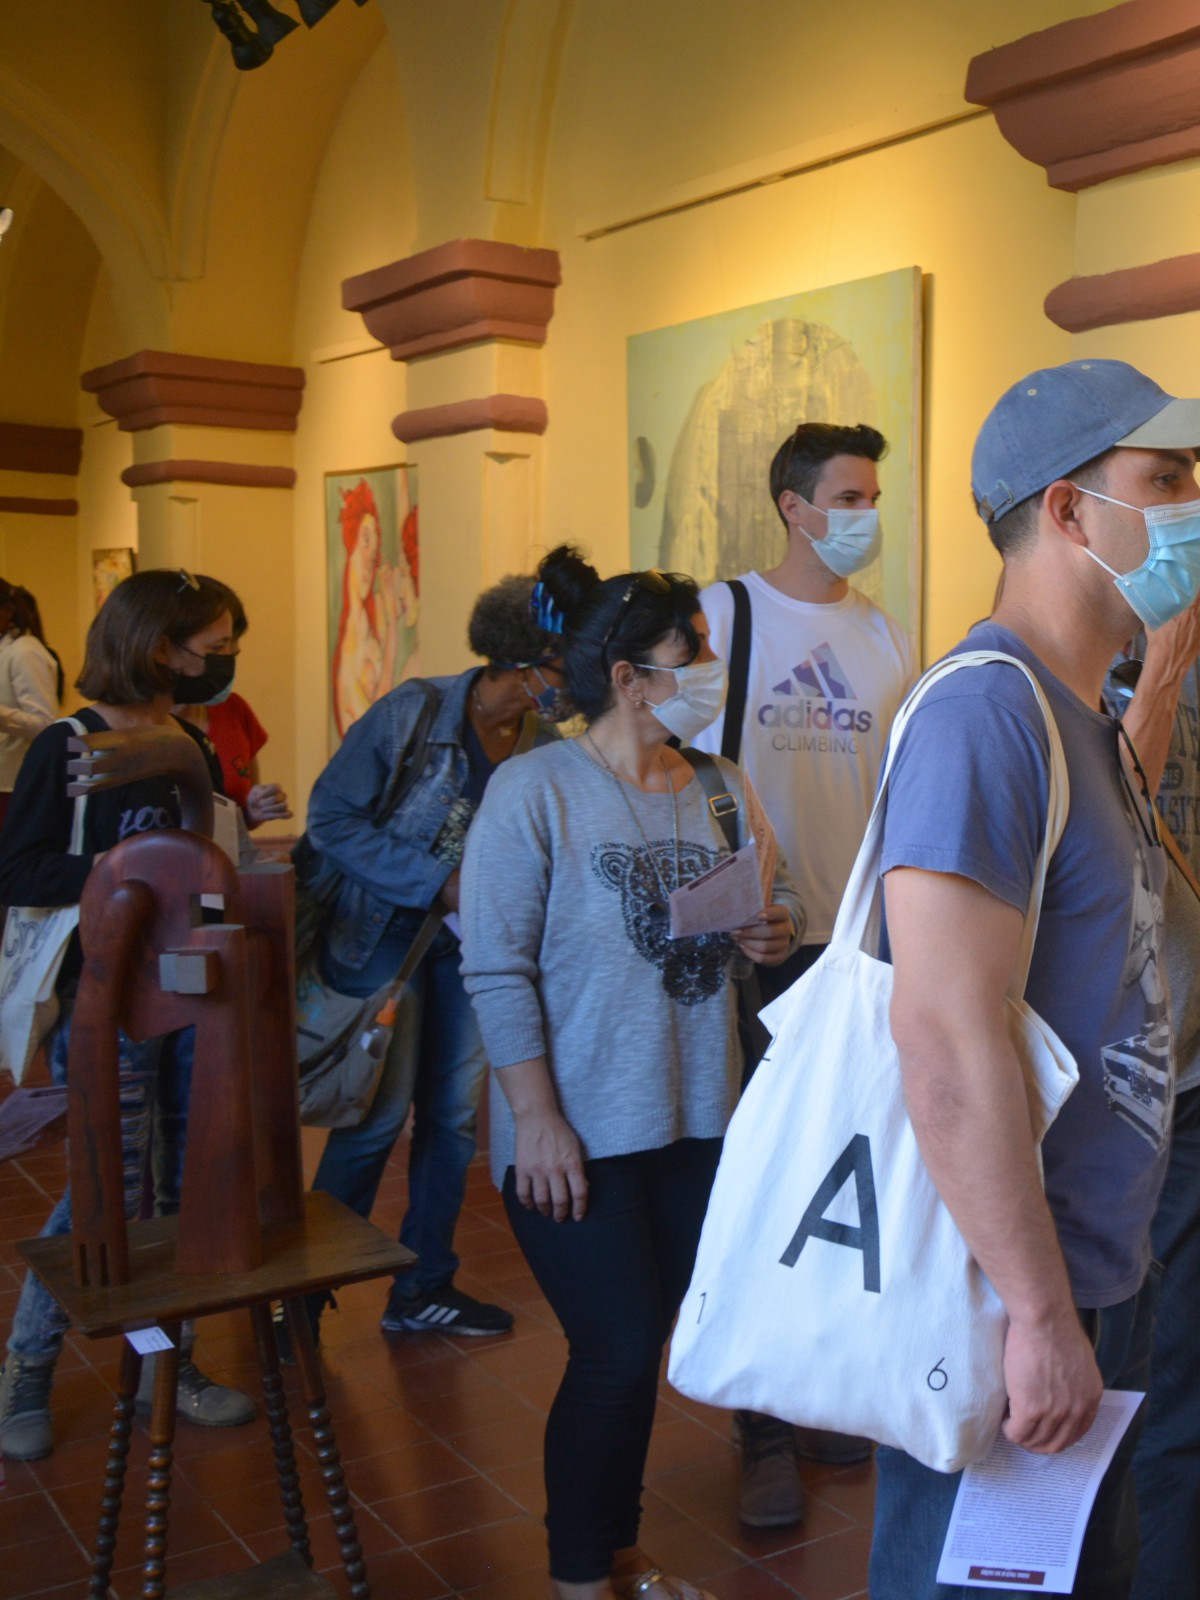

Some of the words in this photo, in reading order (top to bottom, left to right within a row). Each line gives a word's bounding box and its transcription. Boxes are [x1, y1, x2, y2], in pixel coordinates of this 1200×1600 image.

[758, 700, 873, 733] adidas
[772, 734, 859, 755] CLIMBING
[778, 1133, 881, 1294] A
[696, 1291, 708, 1325] 1
[926, 1356, 949, 1392] 6
